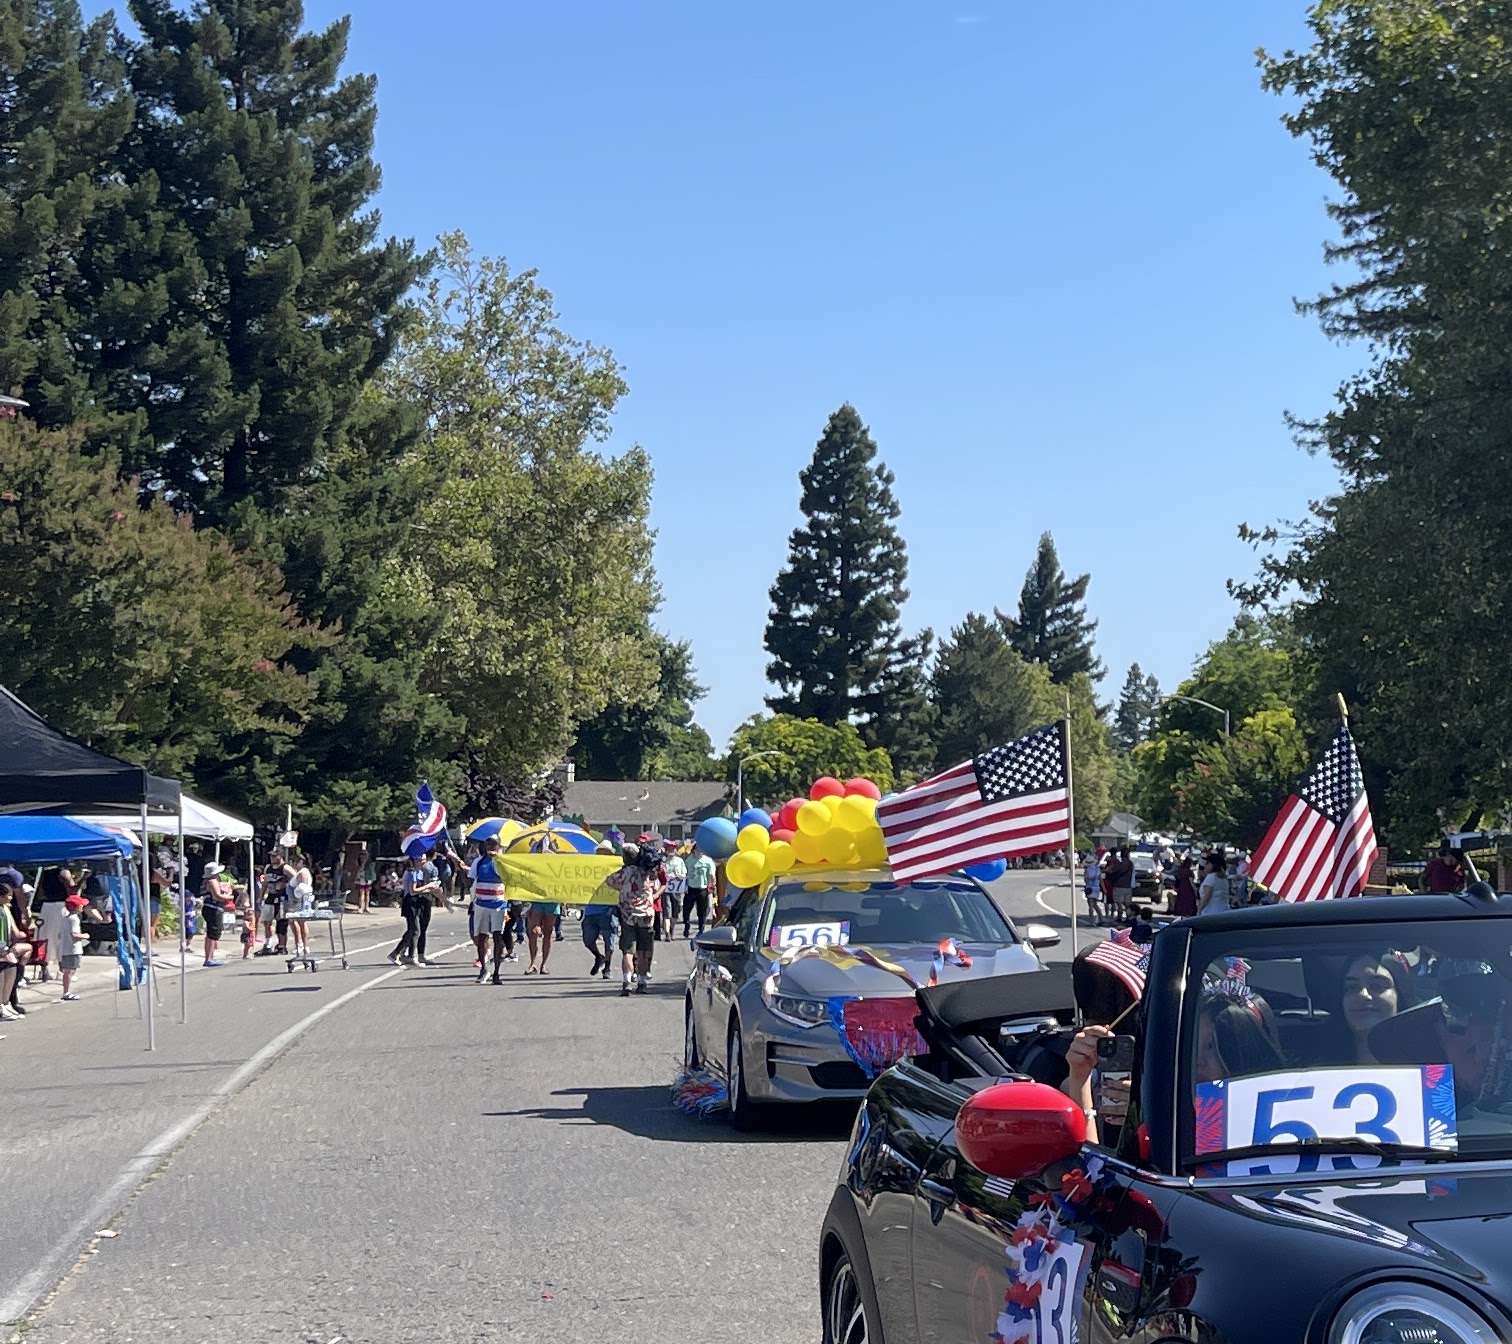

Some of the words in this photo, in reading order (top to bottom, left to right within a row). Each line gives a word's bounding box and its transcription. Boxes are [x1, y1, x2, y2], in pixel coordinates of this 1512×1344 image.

[667, 877, 684, 892] 57
[787, 926, 833, 946] 56
[1250, 1082, 1402, 1175] 53
